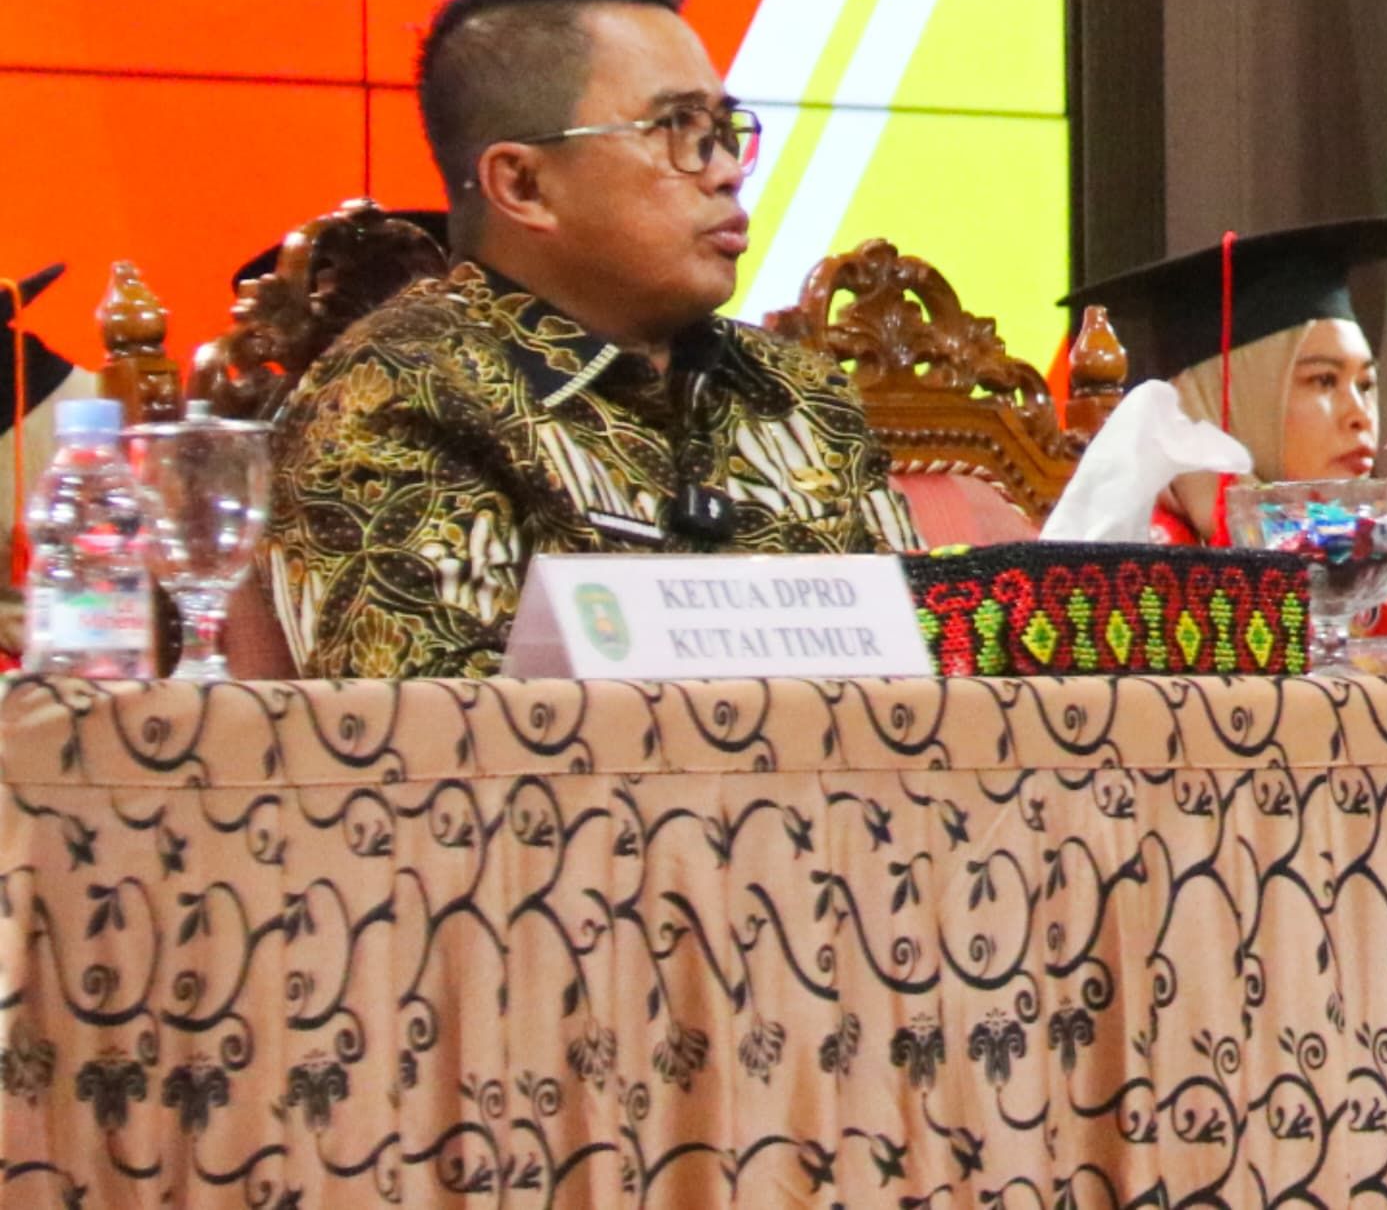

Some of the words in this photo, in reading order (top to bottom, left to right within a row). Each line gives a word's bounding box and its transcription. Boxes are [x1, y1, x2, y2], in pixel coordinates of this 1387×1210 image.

[656, 578, 770, 609] KETUA
[771, 577, 857, 609] DPRD
[667, 627, 773, 659] KUTAI
[771, 626, 884, 658] TIMUR
